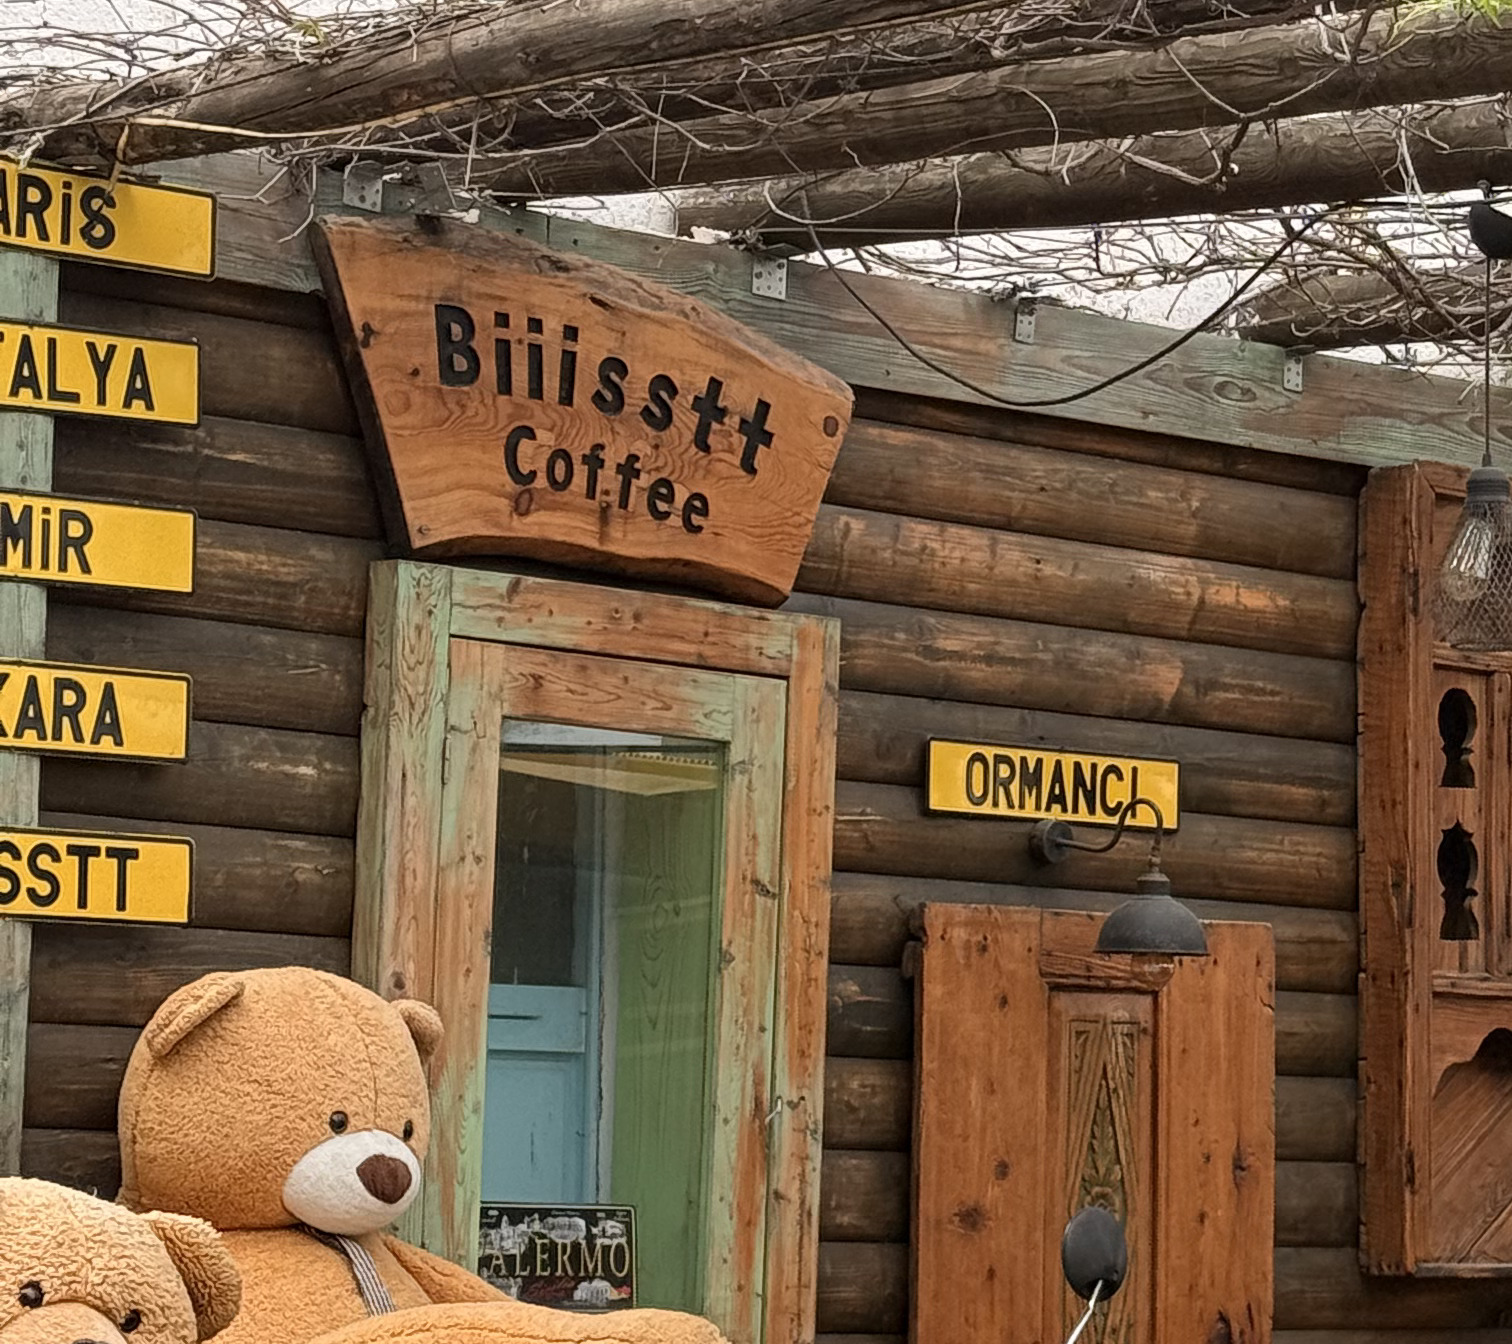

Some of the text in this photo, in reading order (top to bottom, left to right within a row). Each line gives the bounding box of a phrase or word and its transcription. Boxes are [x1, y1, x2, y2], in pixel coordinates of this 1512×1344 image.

[0, 331, 155, 412] ALYA
[434, 303, 775, 476] Biiisstt
[504, 425, 710, 534] Coffee
[965, 752, 1138, 819] ORMANCI
[484, 1238, 631, 1278] ALERMO
